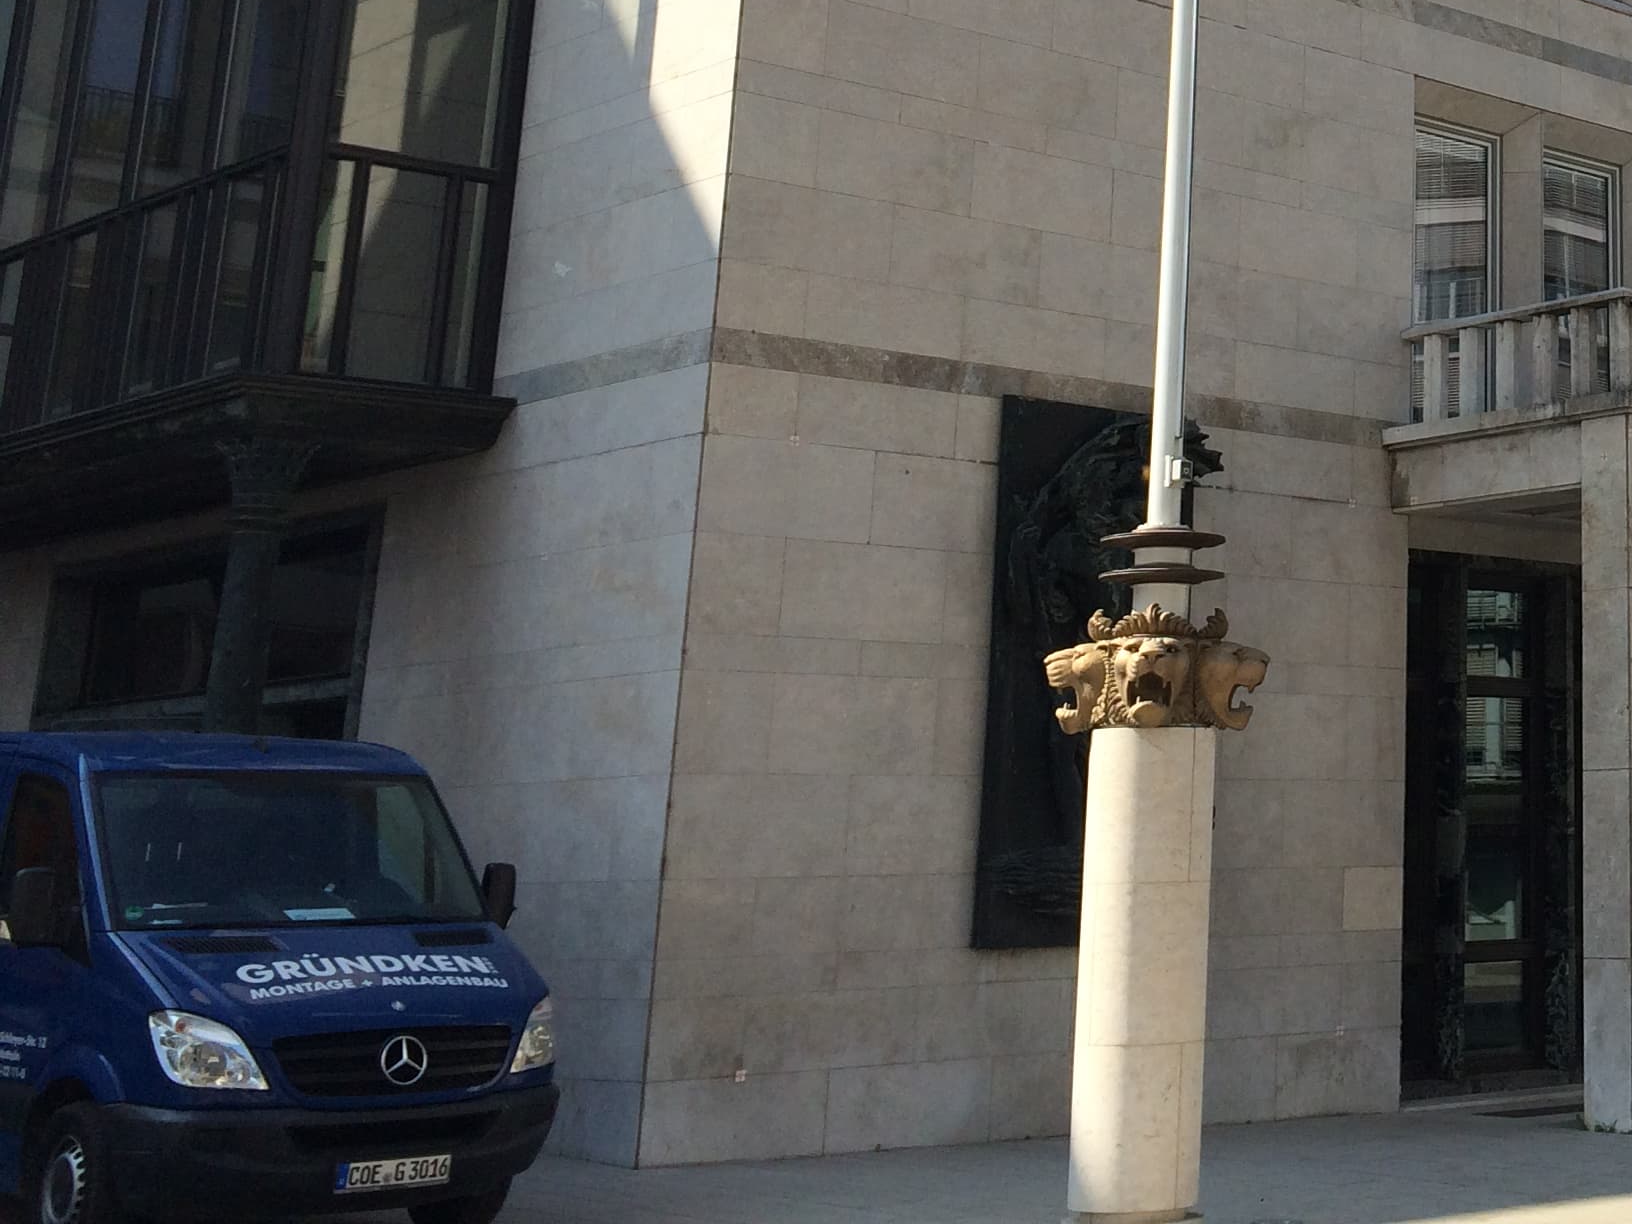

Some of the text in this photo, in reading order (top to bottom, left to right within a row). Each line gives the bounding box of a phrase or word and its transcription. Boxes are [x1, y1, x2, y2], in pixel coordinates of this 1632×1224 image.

[236, 953, 490, 983] GRÜNDKEN
[250, 979, 356, 1000] MONTAGE
[381, 975, 509, 988] ANLAGENBAU
[349, 1157, 448, 1186] COE G 3016
